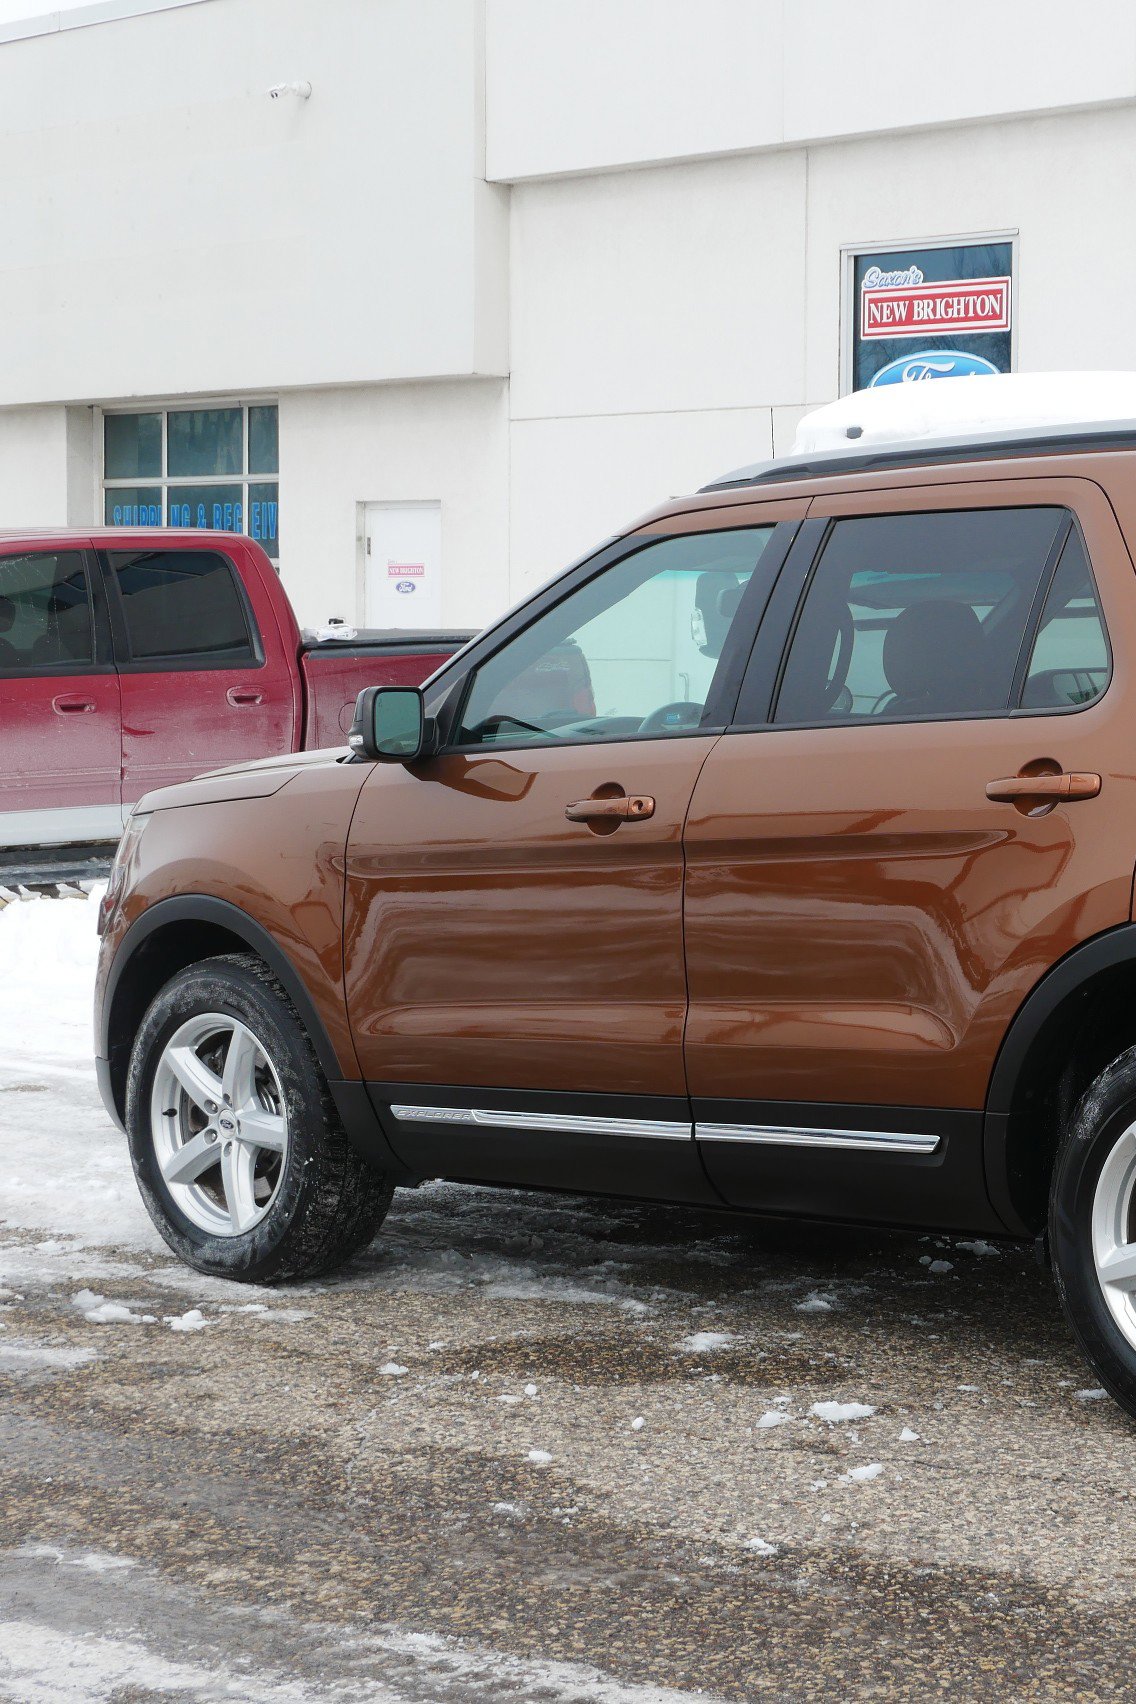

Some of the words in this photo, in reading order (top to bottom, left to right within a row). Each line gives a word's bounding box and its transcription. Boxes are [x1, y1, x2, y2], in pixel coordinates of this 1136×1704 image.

[863, 266, 922, 289] Saxon's
[869, 301, 909, 324] NEW
[913, 294, 1002, 321] BRIGHTON
